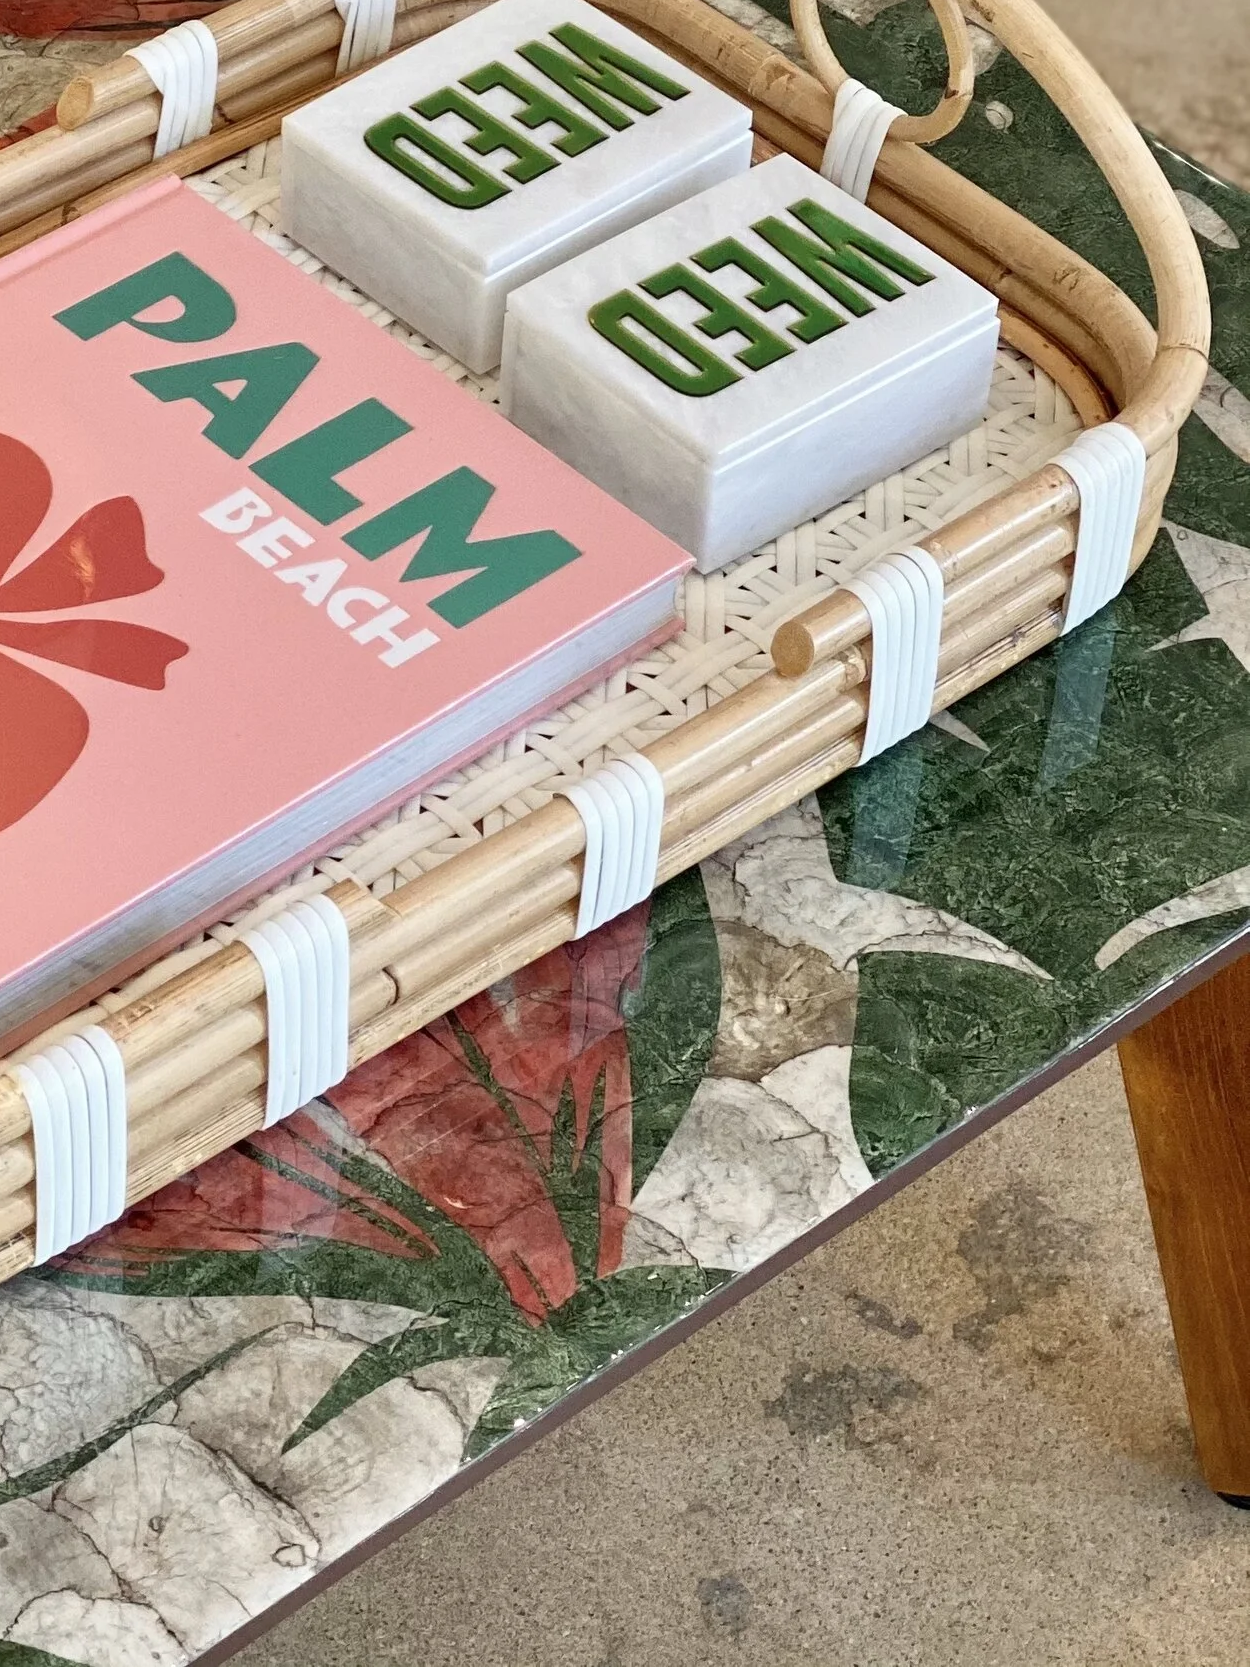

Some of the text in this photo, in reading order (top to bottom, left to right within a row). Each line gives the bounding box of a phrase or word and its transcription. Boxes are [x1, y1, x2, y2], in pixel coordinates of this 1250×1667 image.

[363, 21, 691, 211] WEED
[587, 197, 937, 399] WEED
[51, 250, 583, 629] PALM
[199, 487, 441, 669] BEACH
